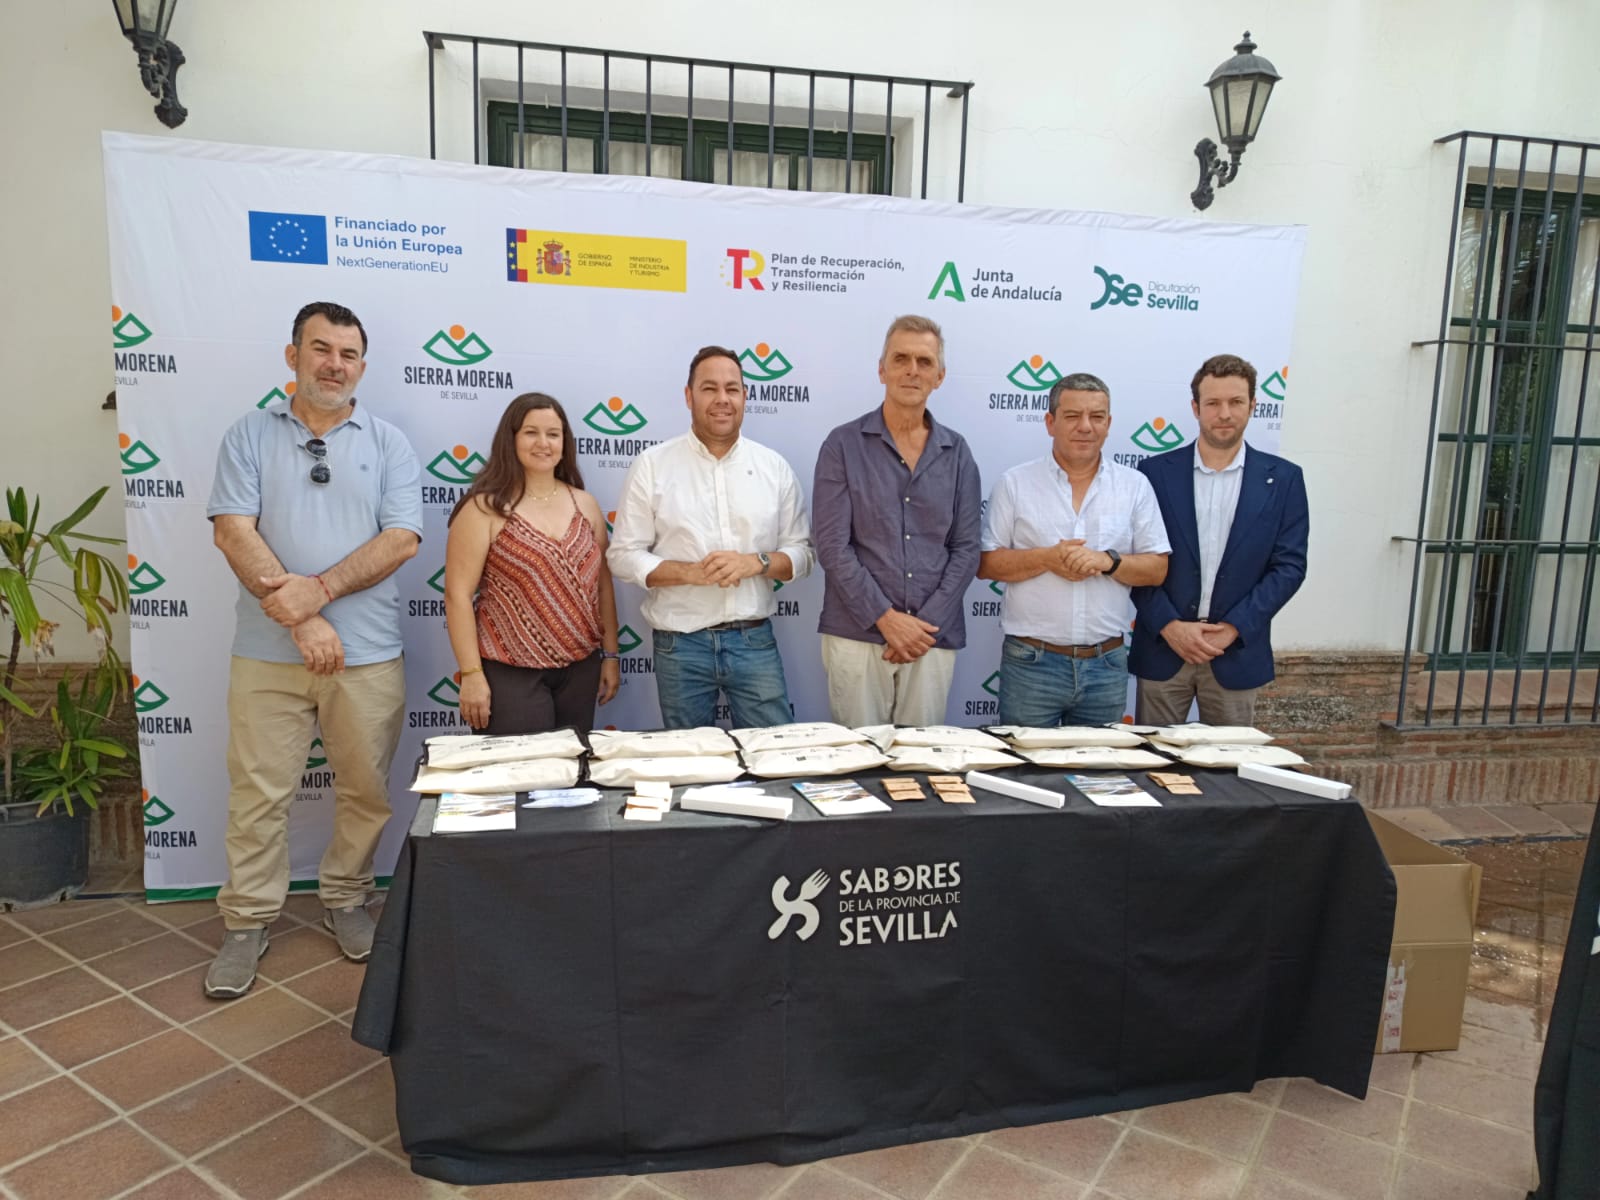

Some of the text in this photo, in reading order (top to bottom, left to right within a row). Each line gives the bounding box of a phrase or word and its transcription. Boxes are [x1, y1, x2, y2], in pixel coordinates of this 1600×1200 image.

[335, 216, 446, 237] Financiado por
[336, 235, 463, 256] la Unión Europea
[336, 256, 449, 273] NextGenerationEU
[578, 252, 612, 261] GOBIERNO
[578, 259, 612, 268] DE ESPAÑA
[629, 256, 662, 264] MINISTERIO
[771, 253, 905, 272] Plan de Recuperación,
[638, 263, 670, 271] INDUSTRIA
[771, 266, 865, 281] Transformación
[972, 268, 1014, 284] Junta
[772, 280, 847, 293] y Resiliencia
[971, 285, 1063, 302] de Andalucía
[1148, 280, 1200, 295] Diputación
[1147, 293, 1199, 311] Sevilla
[114, 352, 177, 374] MORENA
[404, 366, 514, 390] SIERRA MORENA
[441, 390, 478, 401] DE SEVILLA
[760, 384, 810, 403] MORENA
[989, 393, 1028, 410] SIERRA
[754, 405, 778, 415] SEVILLA
[614, 438, 664, 457] MORE
[598, 460, 606, 469] DE
[125, 478, 185, 498] MORENA
[422, 486, 456, 504] ERRA
[130, 598, 188, 618] MORENA
[772, 600, 800, 617] ENA
[619, 656, 655, 675] OREN
[409, 710, 456, 728] SIERRA
[301, 772, 336, 789] MOR
[839, 861, 961, 896] SABORES
[840, 891, 961, 913] DE LA PROVINCIA DE
[839, 909, 958, 947] SEVILLA
